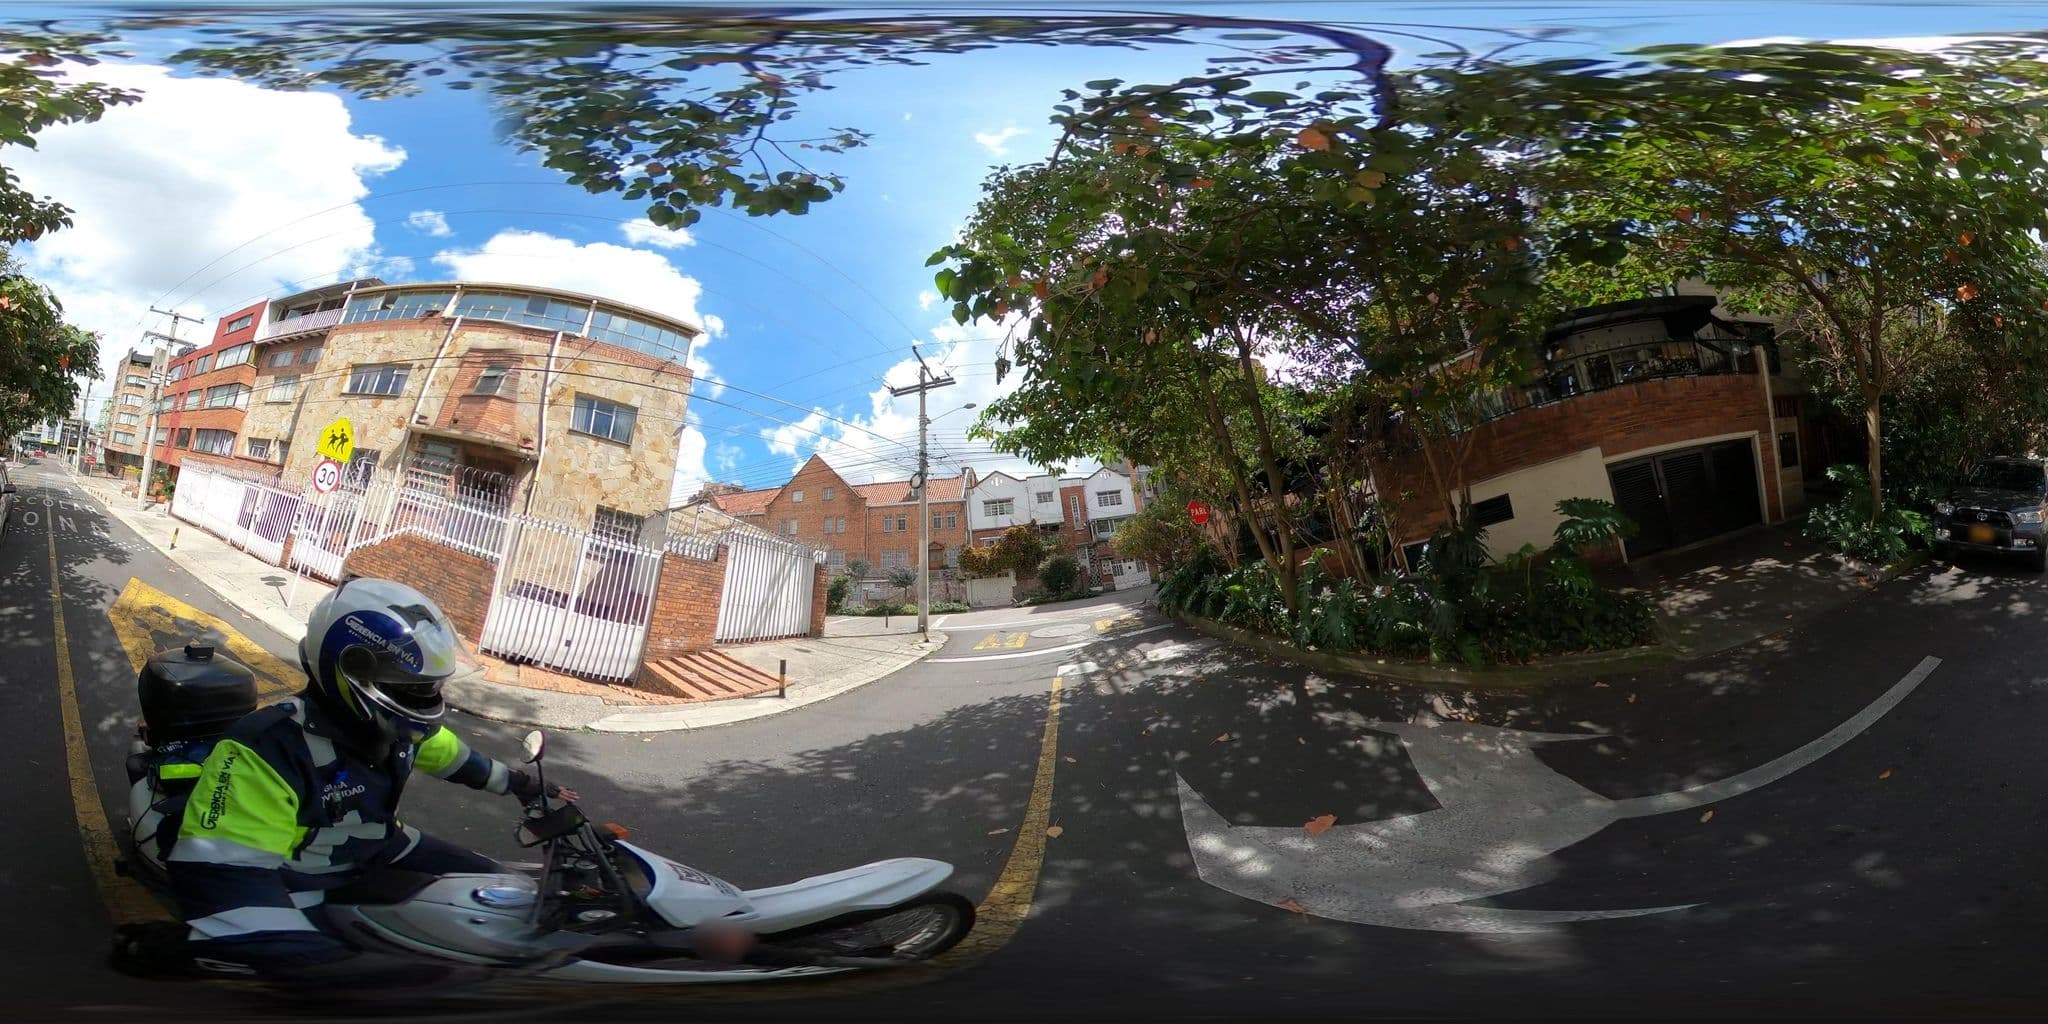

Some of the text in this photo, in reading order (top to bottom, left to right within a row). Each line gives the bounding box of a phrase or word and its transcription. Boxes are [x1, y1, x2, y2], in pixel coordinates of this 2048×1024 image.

[318, 468, 335, 486] 30
[345, 615, 387, 646] GERENCIA
[387, 642, 400, 656] EN
[201, 784, 223, 830] GERENCIA
